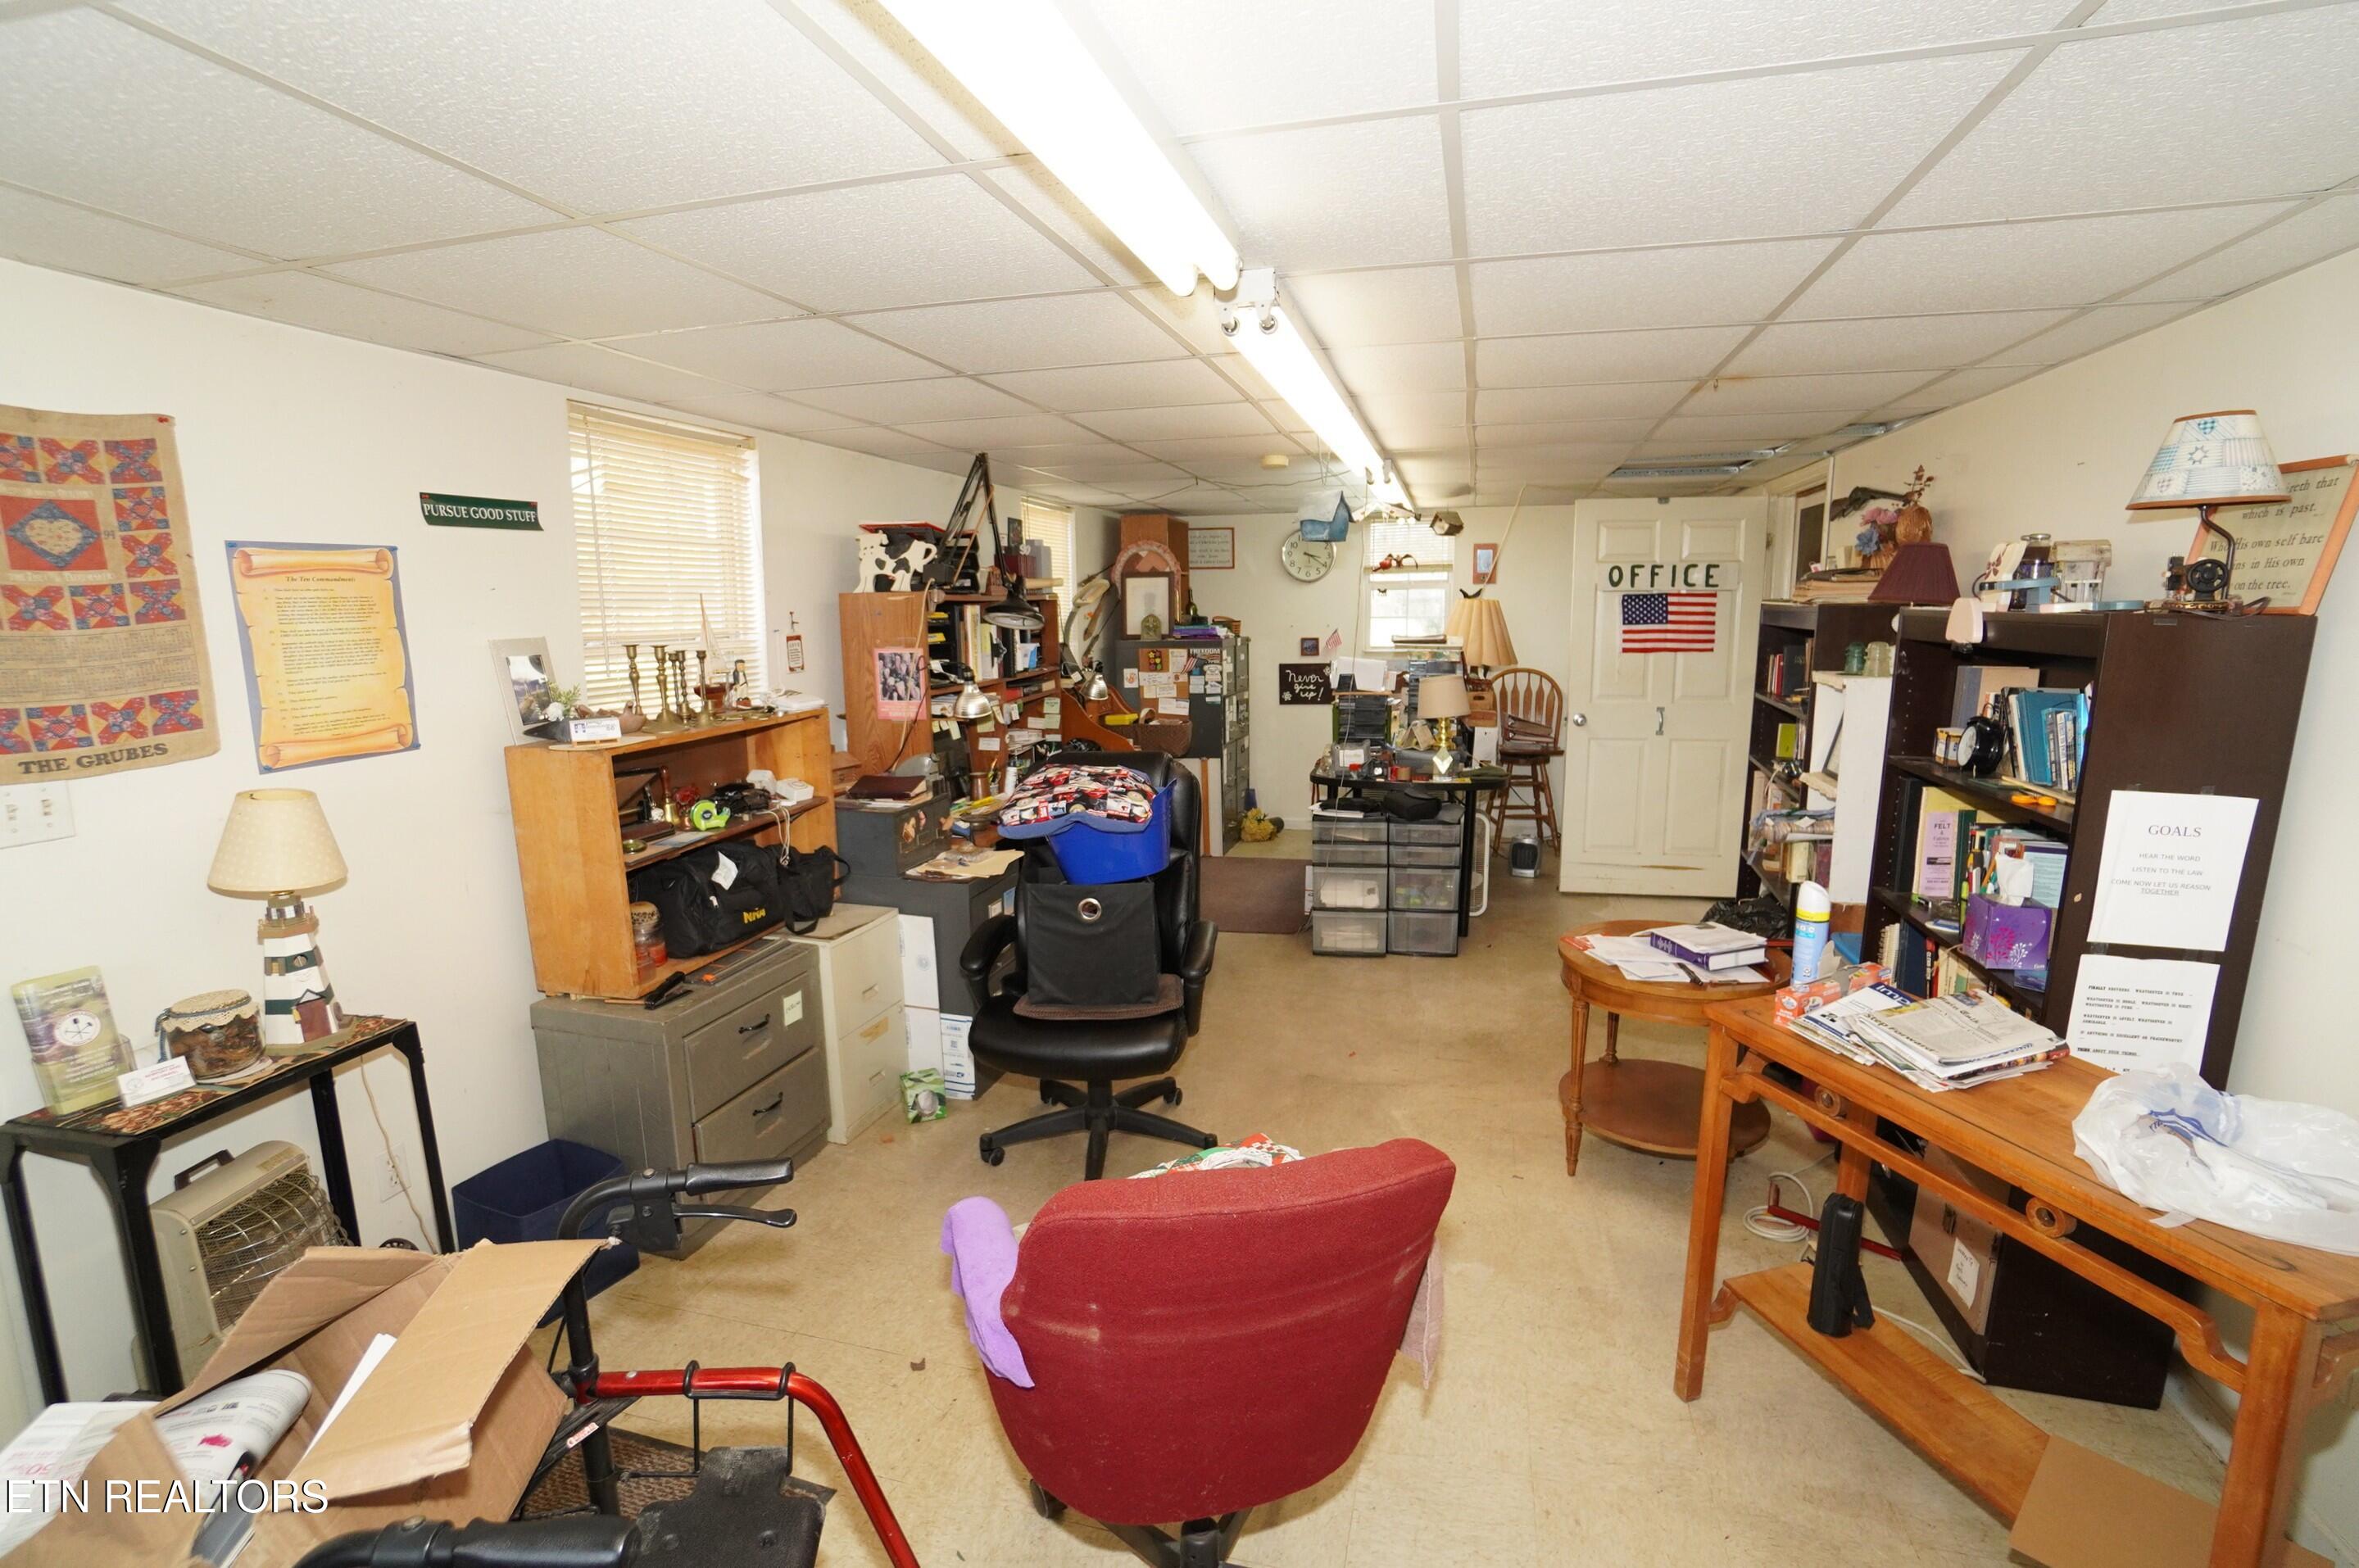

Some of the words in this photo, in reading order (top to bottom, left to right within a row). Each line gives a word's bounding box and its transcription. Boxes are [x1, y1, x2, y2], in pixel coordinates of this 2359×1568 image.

[2316, 476, 2339, 489] that
[423, 503, 469, 518] PURSUE
[470, 506, 504, 520] GOOD
[506, 510, 537, 523] STUFF
[2242, 506, 2269, 520] which
[2274, 506, 2284, 517] is
[2289, 503, 2316, 518] past.
[2251, 540, 2271, 549] own
[2275, 533, 2298, 546] self
[2299, 533, 2325, 545] bare
[2264, 557, 2280, 569] His
[2282, 558, 2305, 568] own
[1608, 564, 1720, 587] OFFICE
[2234, 582, 2245, 591] on
[2248, 579, 2263, 590] the
[2266, 580, 2290, 590] tree.
[17, 757, 70, 774] THE
[75, 742, 169, 768] GRUBES
[2148, 824, 2202, 837] GOALS
[2180, 882, 2211, 891] REASON
[1864, 1013, 1889, 1027] Step
